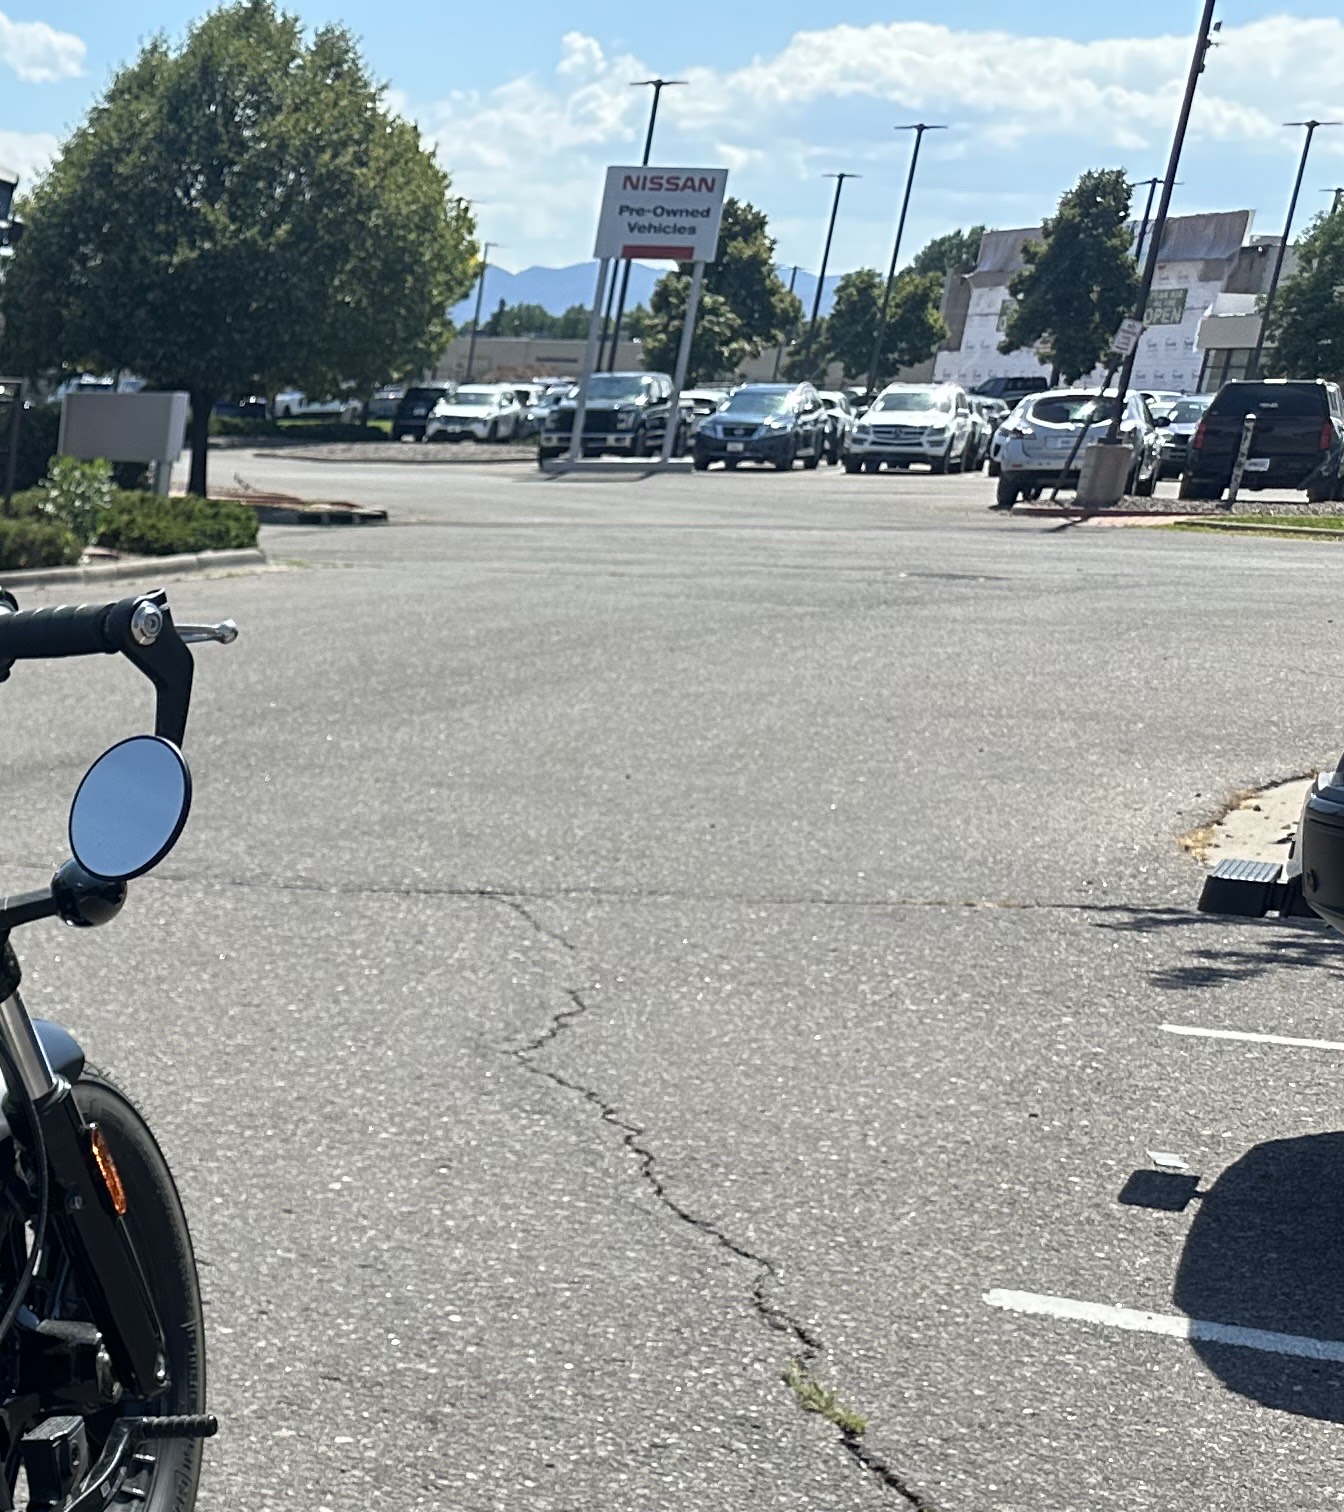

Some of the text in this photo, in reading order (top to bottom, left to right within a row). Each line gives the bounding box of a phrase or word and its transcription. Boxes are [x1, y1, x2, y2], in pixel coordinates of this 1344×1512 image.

[623, 175, 716, 193] NISSAN
[618, 204, 711, 218] Pre-Owned
[627, 222, 697, 236] Vehicles
